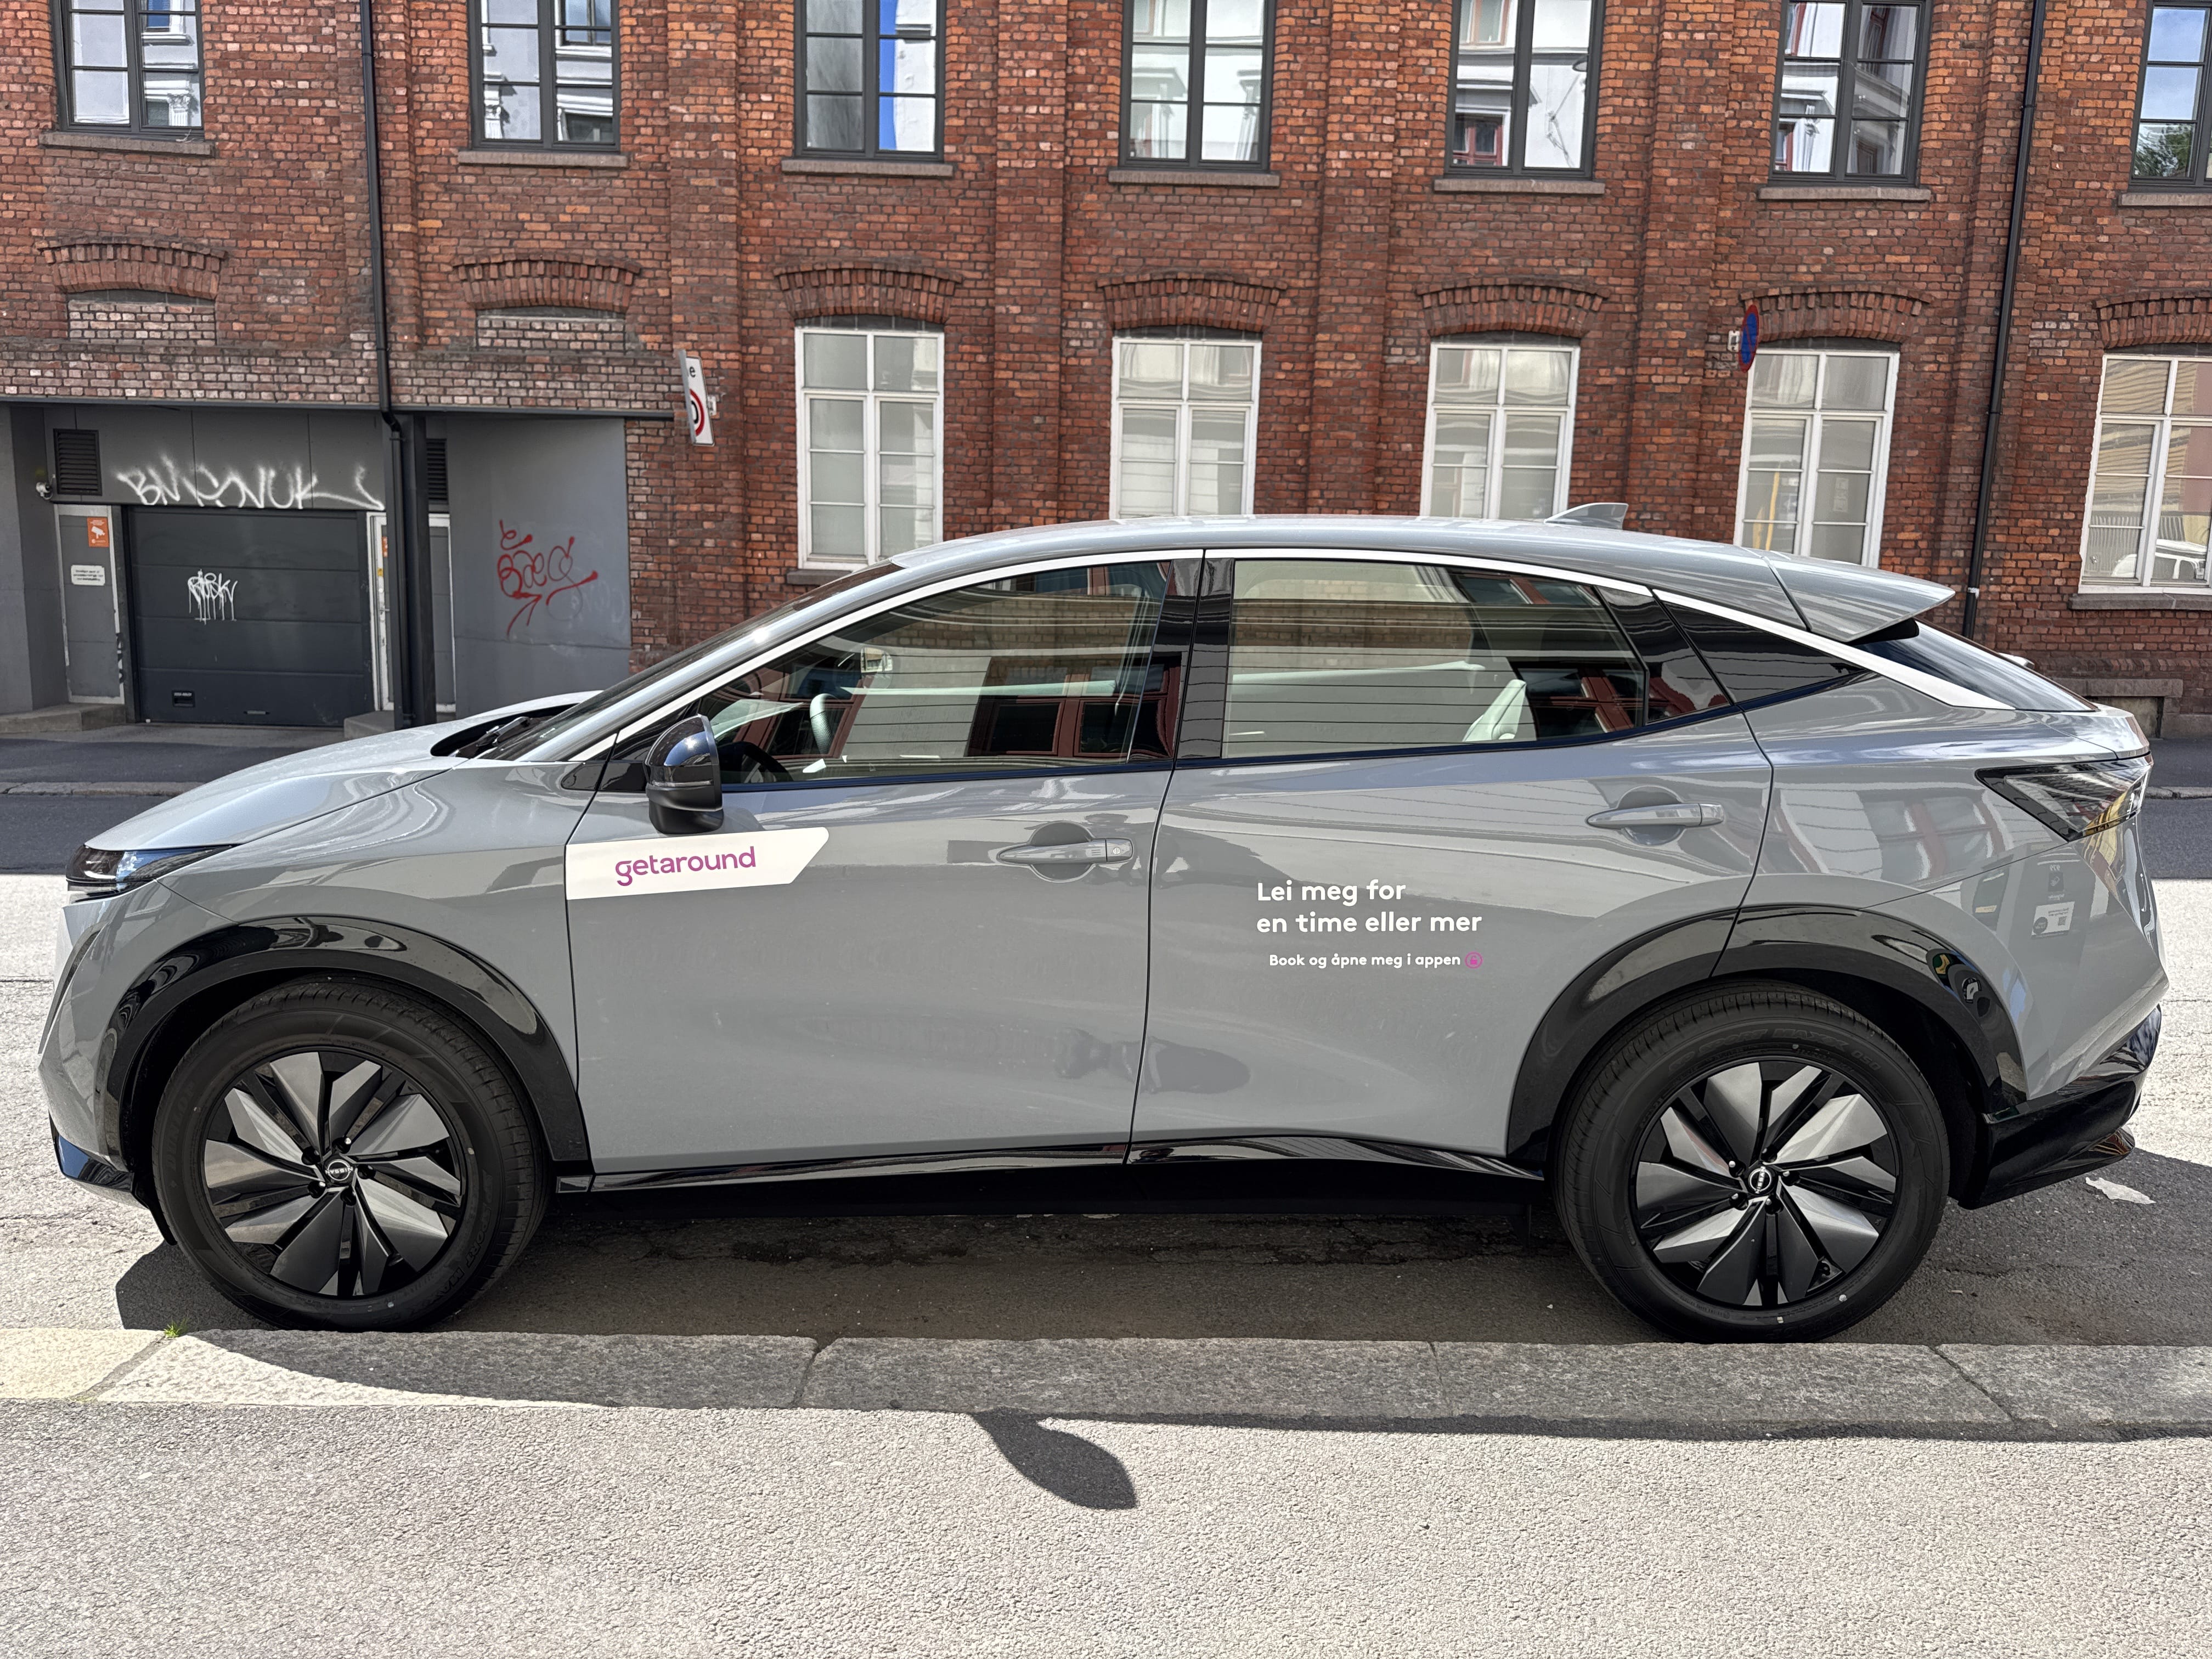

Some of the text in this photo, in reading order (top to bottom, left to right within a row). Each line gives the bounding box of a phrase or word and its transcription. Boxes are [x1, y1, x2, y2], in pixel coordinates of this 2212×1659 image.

[615, 846, 756, 886] getaround
[1257, 879, 1406, 906] Lei meg for
[1257, 911, 1482, 933] en time eller mer
[1269, 953, 1460, 968] Book og åpne meg i appen
[1699, 1030, 1768, 1052] SPORT
[1774, 1029, 1850, 1052] MAXX
[1756, 1166, 1765, 1194] NISSAN
[465, 1203, 493, 1267] SPORT
